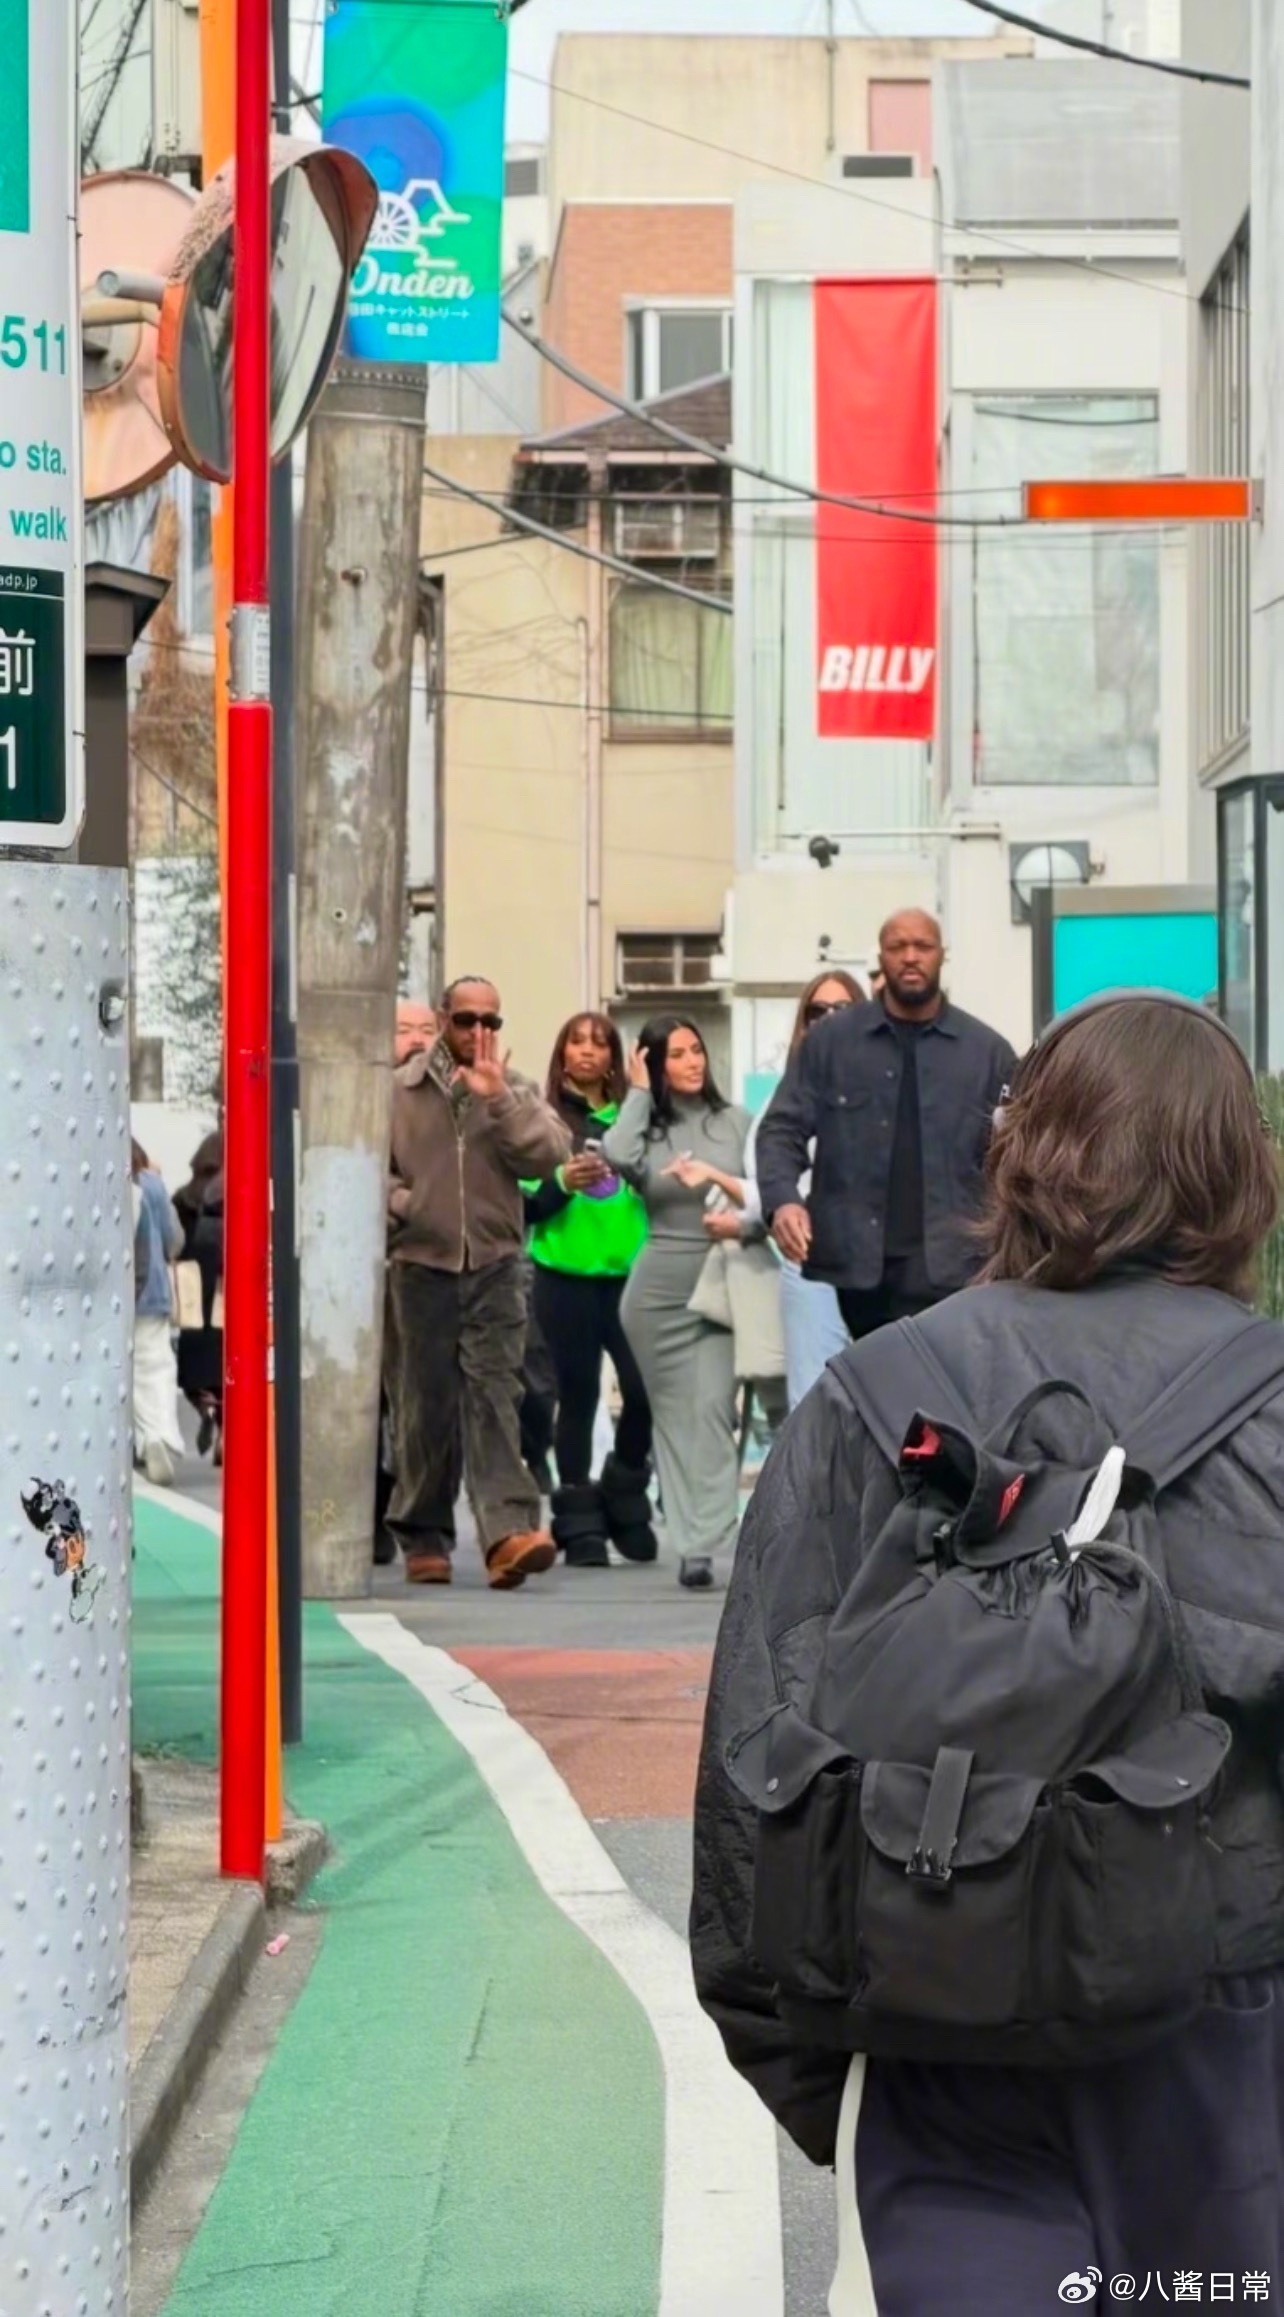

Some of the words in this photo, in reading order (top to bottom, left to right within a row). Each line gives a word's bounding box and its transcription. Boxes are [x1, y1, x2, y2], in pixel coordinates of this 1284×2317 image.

[350, 254, 475, 300] Onden
[0, 314, 66, 376] 511
[26, 439, 67, 476] sta.
[10, 505, 67, 542] walk
[819, 644, 936, 693] BILLY
